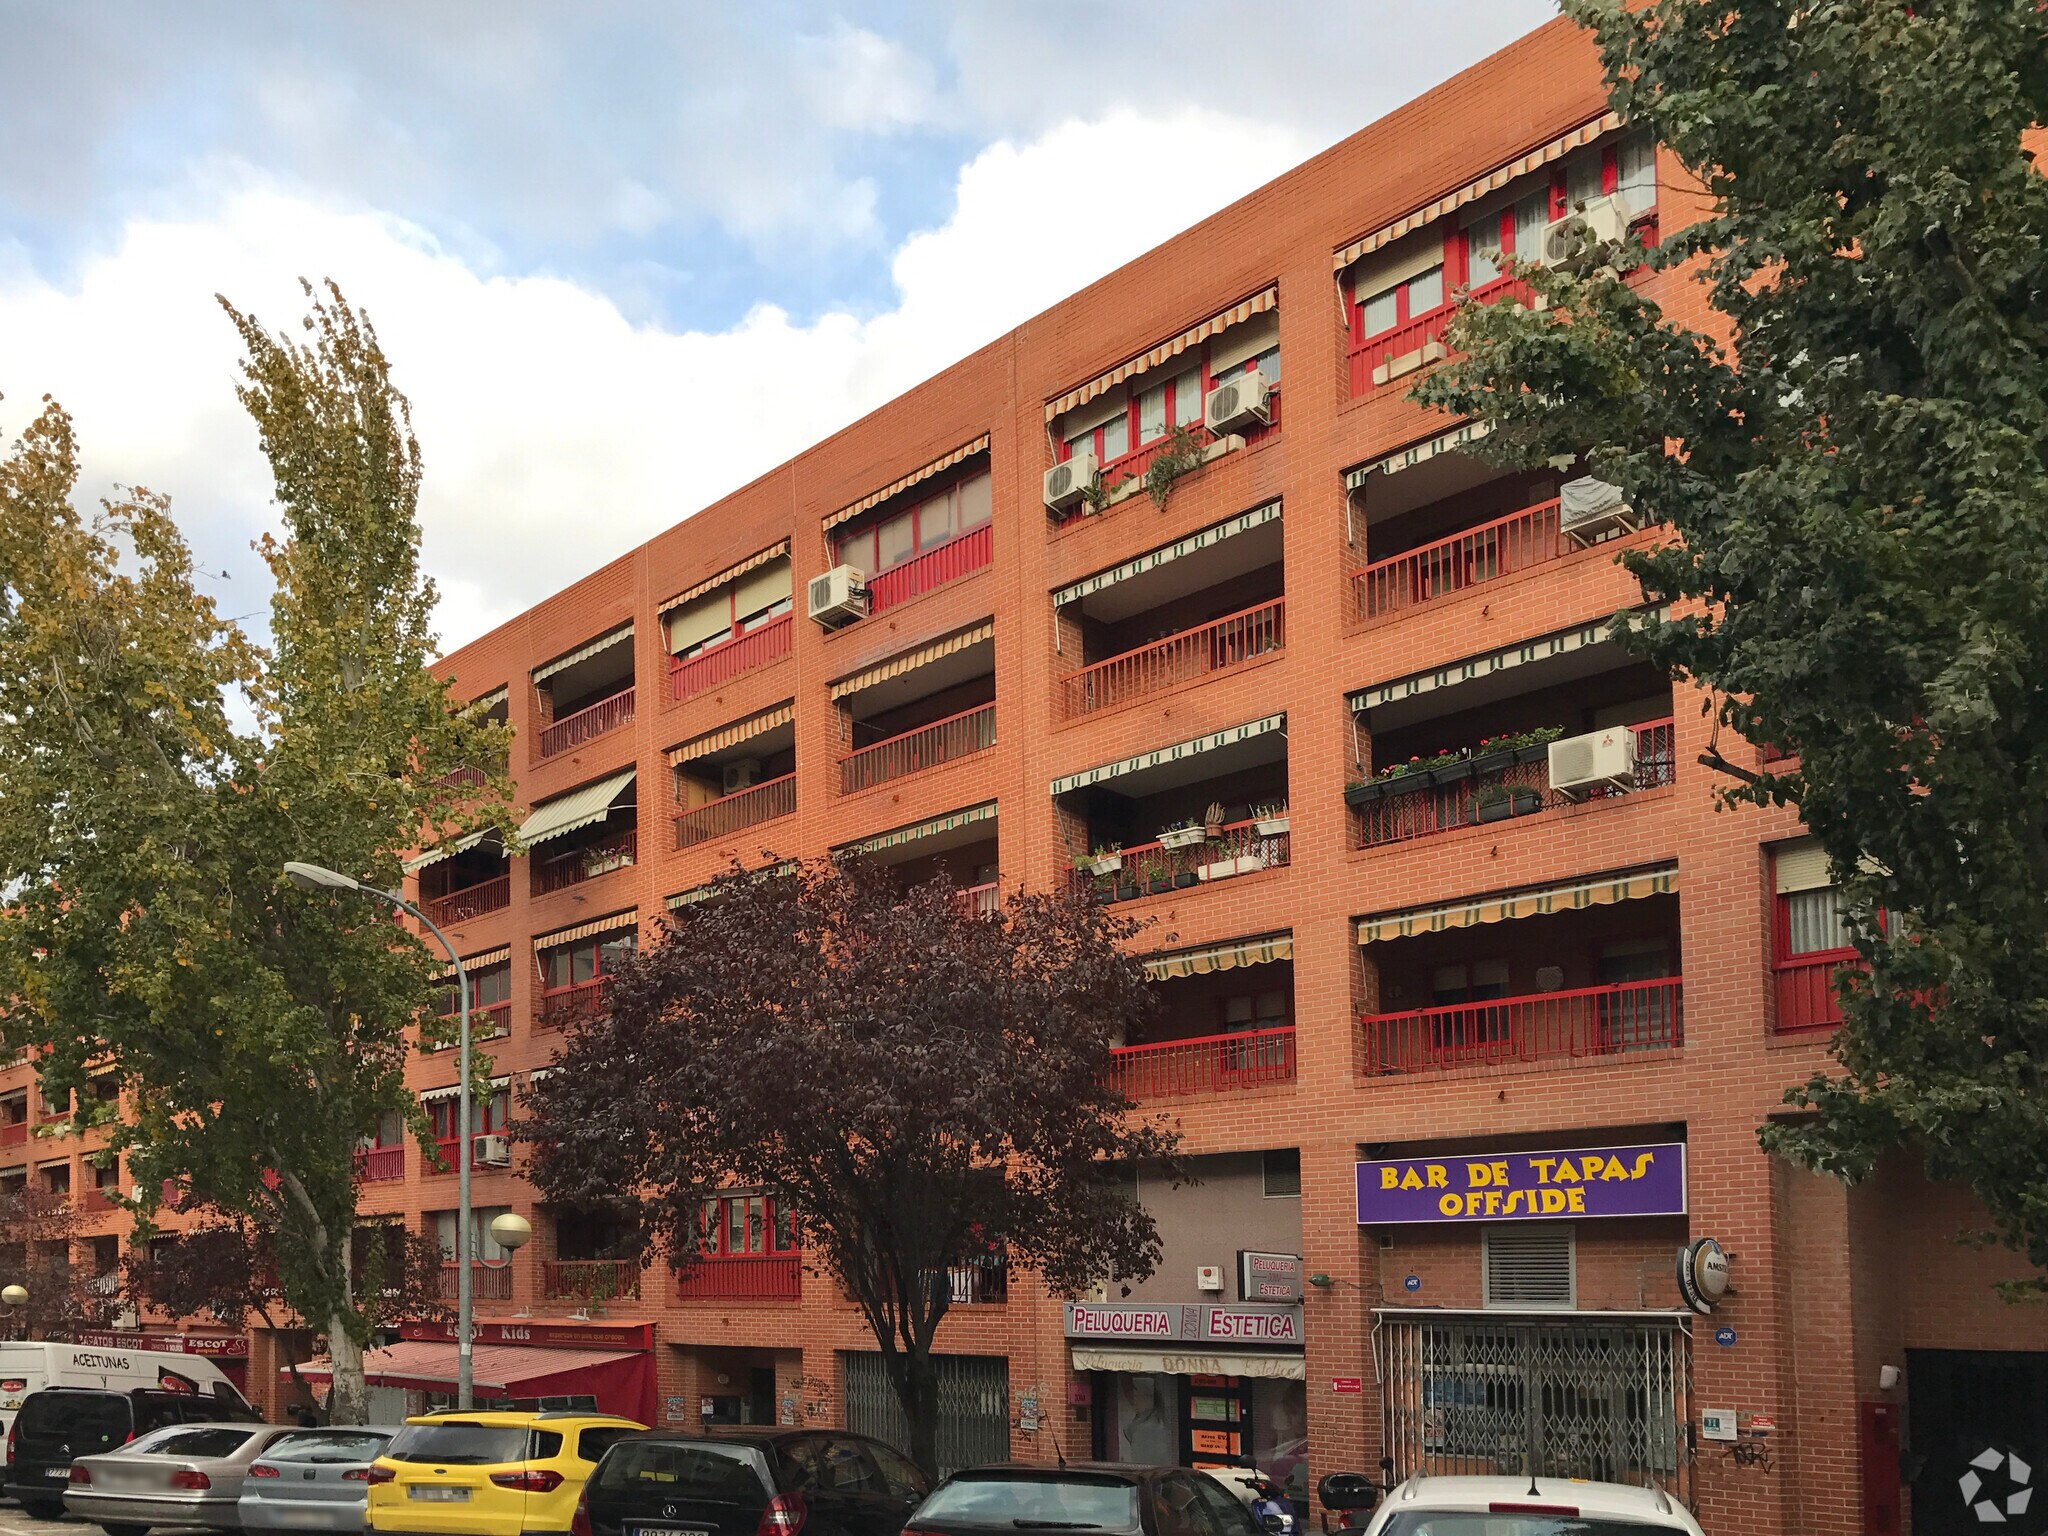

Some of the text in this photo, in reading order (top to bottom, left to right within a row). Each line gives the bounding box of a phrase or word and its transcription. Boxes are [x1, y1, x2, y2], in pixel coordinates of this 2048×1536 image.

[1380, 1152, 1654, 1190] BAR DE TAPAS
[1439, 1186, 1586, 1216] OFFSIDE
[1253, 1257, 1295, 1272] PELUQUERIA
[1259, 1283, 1291, 1296] ESTETICA
[1073, 1307, 1171, 1336] PELUQUERIA
[1208, 1307, 1296, 1339] ESTETICA
[501, 1326, 531, 1340] Kids
[116, 1336, 143, 1350] ESCOT
[188, 1339, 228, 1349] ESCOT
[72, 1354, 130, 1369] ACEITUNAS
[1163, 1357, 1221, 1374] DONNA
